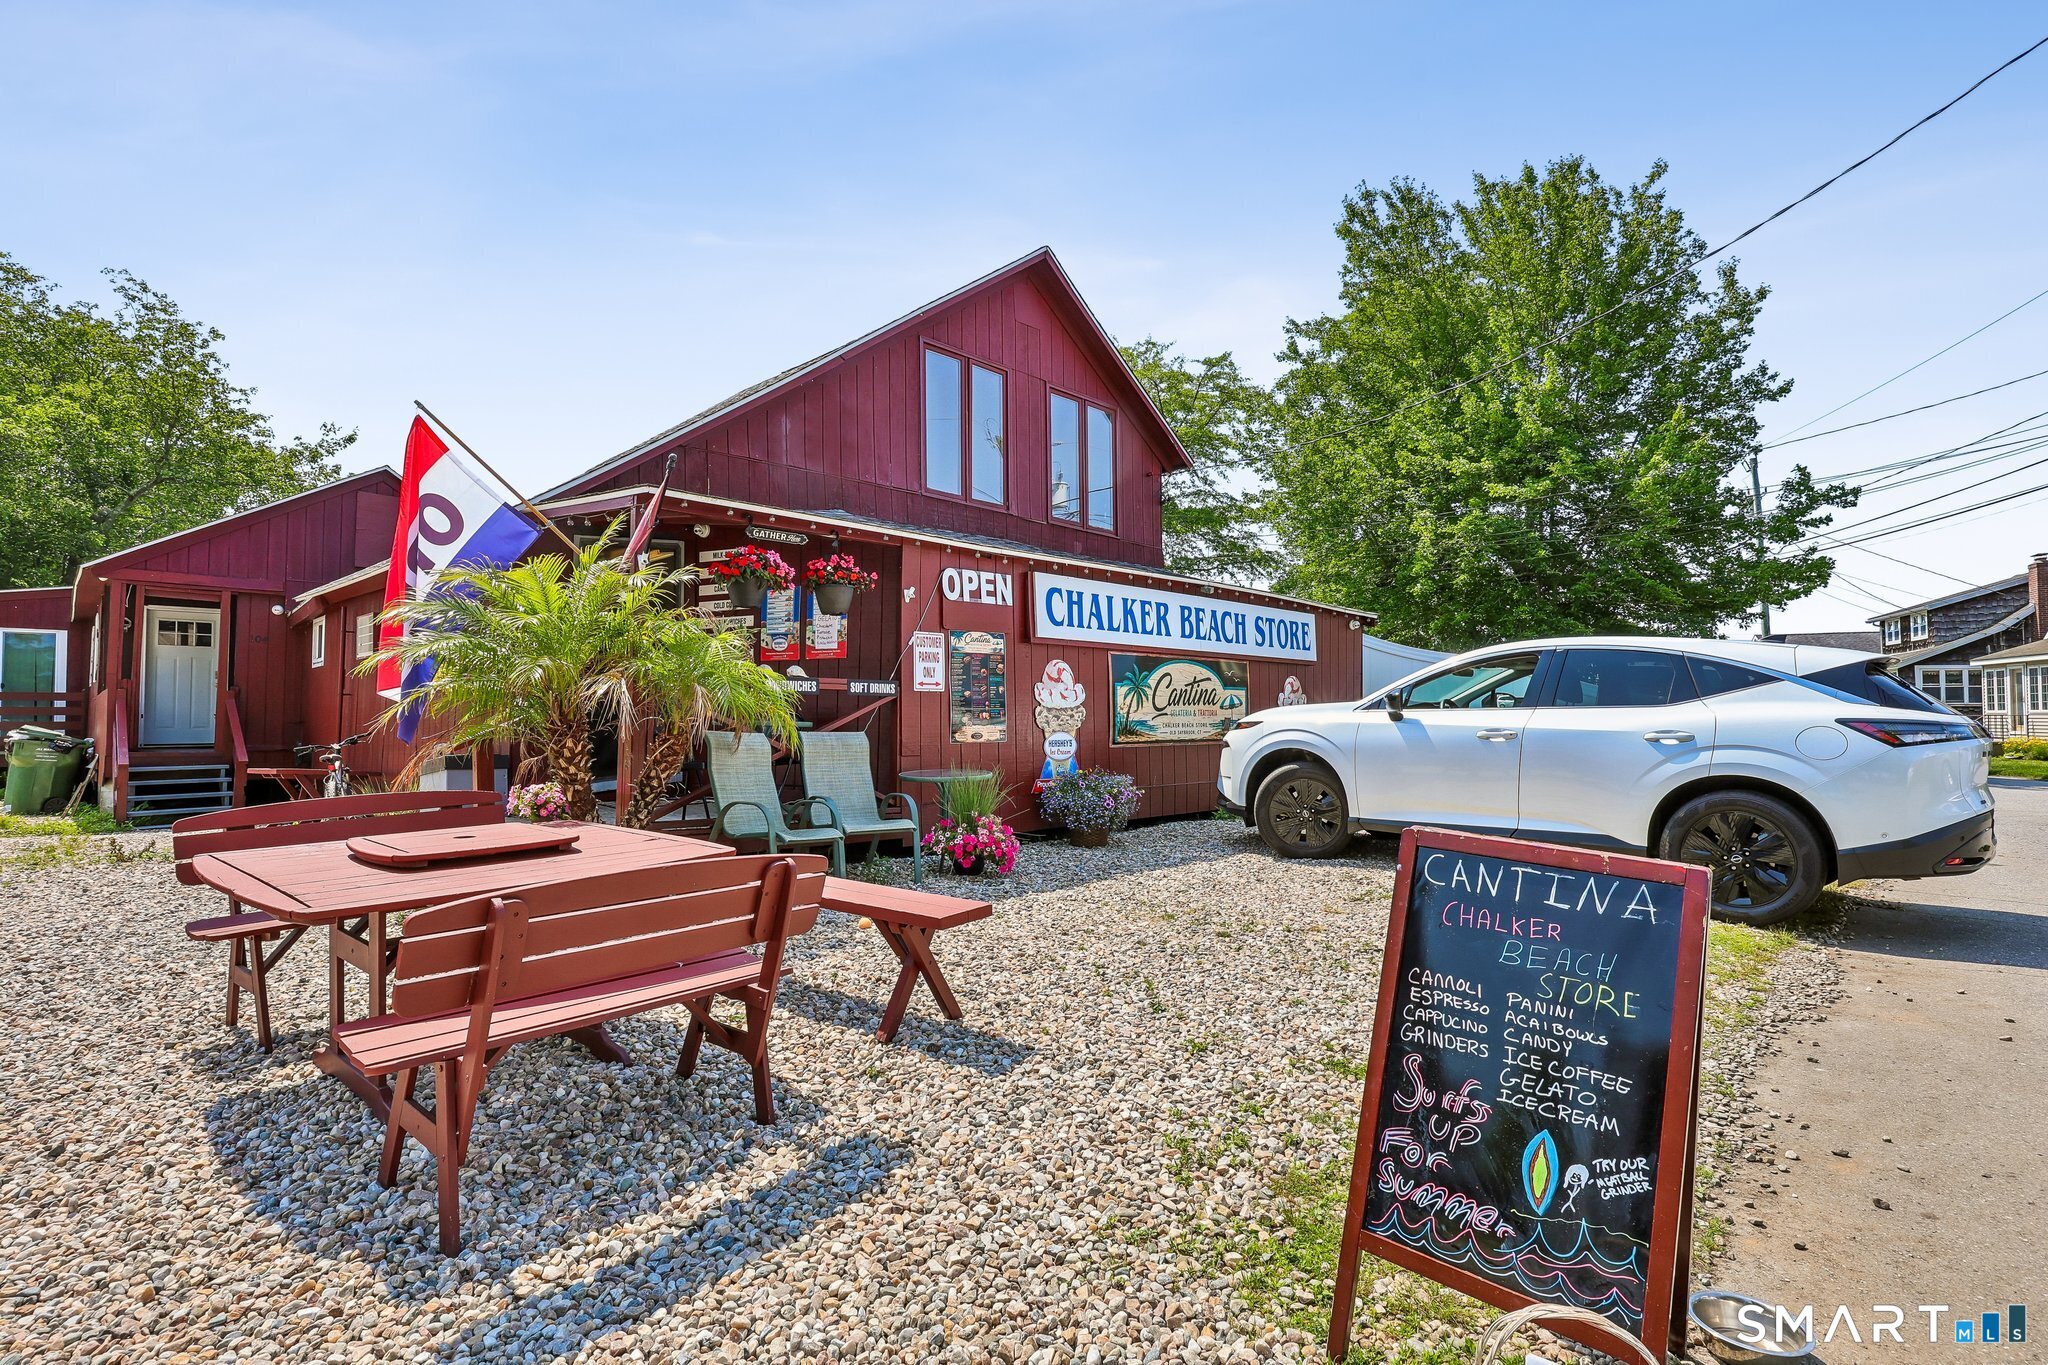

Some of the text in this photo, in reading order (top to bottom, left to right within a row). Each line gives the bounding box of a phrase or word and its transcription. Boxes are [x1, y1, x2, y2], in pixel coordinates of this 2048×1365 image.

[752, 528, 787, 541] GATHER
[942, 567, 1013, 607] OPEN
[713, 602, 725, 610] COLD
[1045, 587, 1312, 652] CHALKER BEACH STORE
[916, 635, 942, 648] CUSTOMER
[964, 633, 991, 646] Cantina
[918, 651, 940, 663] PARKING
[922, 667, 936, 679] ONLY
[850, 682, 868, 693] SOFT
[870, 682, 896, 694] DRINKS
[1152, 672, 1221, 713] Cantina
[1170, 709, 1218, 717] GELATERIA & TRATTORIA
[1048, 739, 1073, 747] HERSHEY'S
[1424, 853, 1658, 925] CANTINA
[1442, 901, 1562, 942] CHALKER
[1499, 940, 1618, 982] BEACH
[1408, 967, 1482, 998] CANNOLI
[1537, 973, 1640, 1019] STORE
[1410, 986, 1490, 1015] ESPRESSO
[1506, 992, 1574, 1020] PANINI
[1402, 1004, 1488, 1035] CAPPUCINO
[1504, 1011, 1609, 1046] ACAI BOWLS
[1400, 1023, 1489, 1058] GRINDERS
[1503, 1028, 1573, 1057] CANDY
[1502, 1046, 1633, 1094] ICE COFFEE
[1499, 1068, 1597, 1106] GELATO
[1592, 1156, 1650, 1173] TRY OUR
[1600, 1181, 1653, 1201] GRINDER
